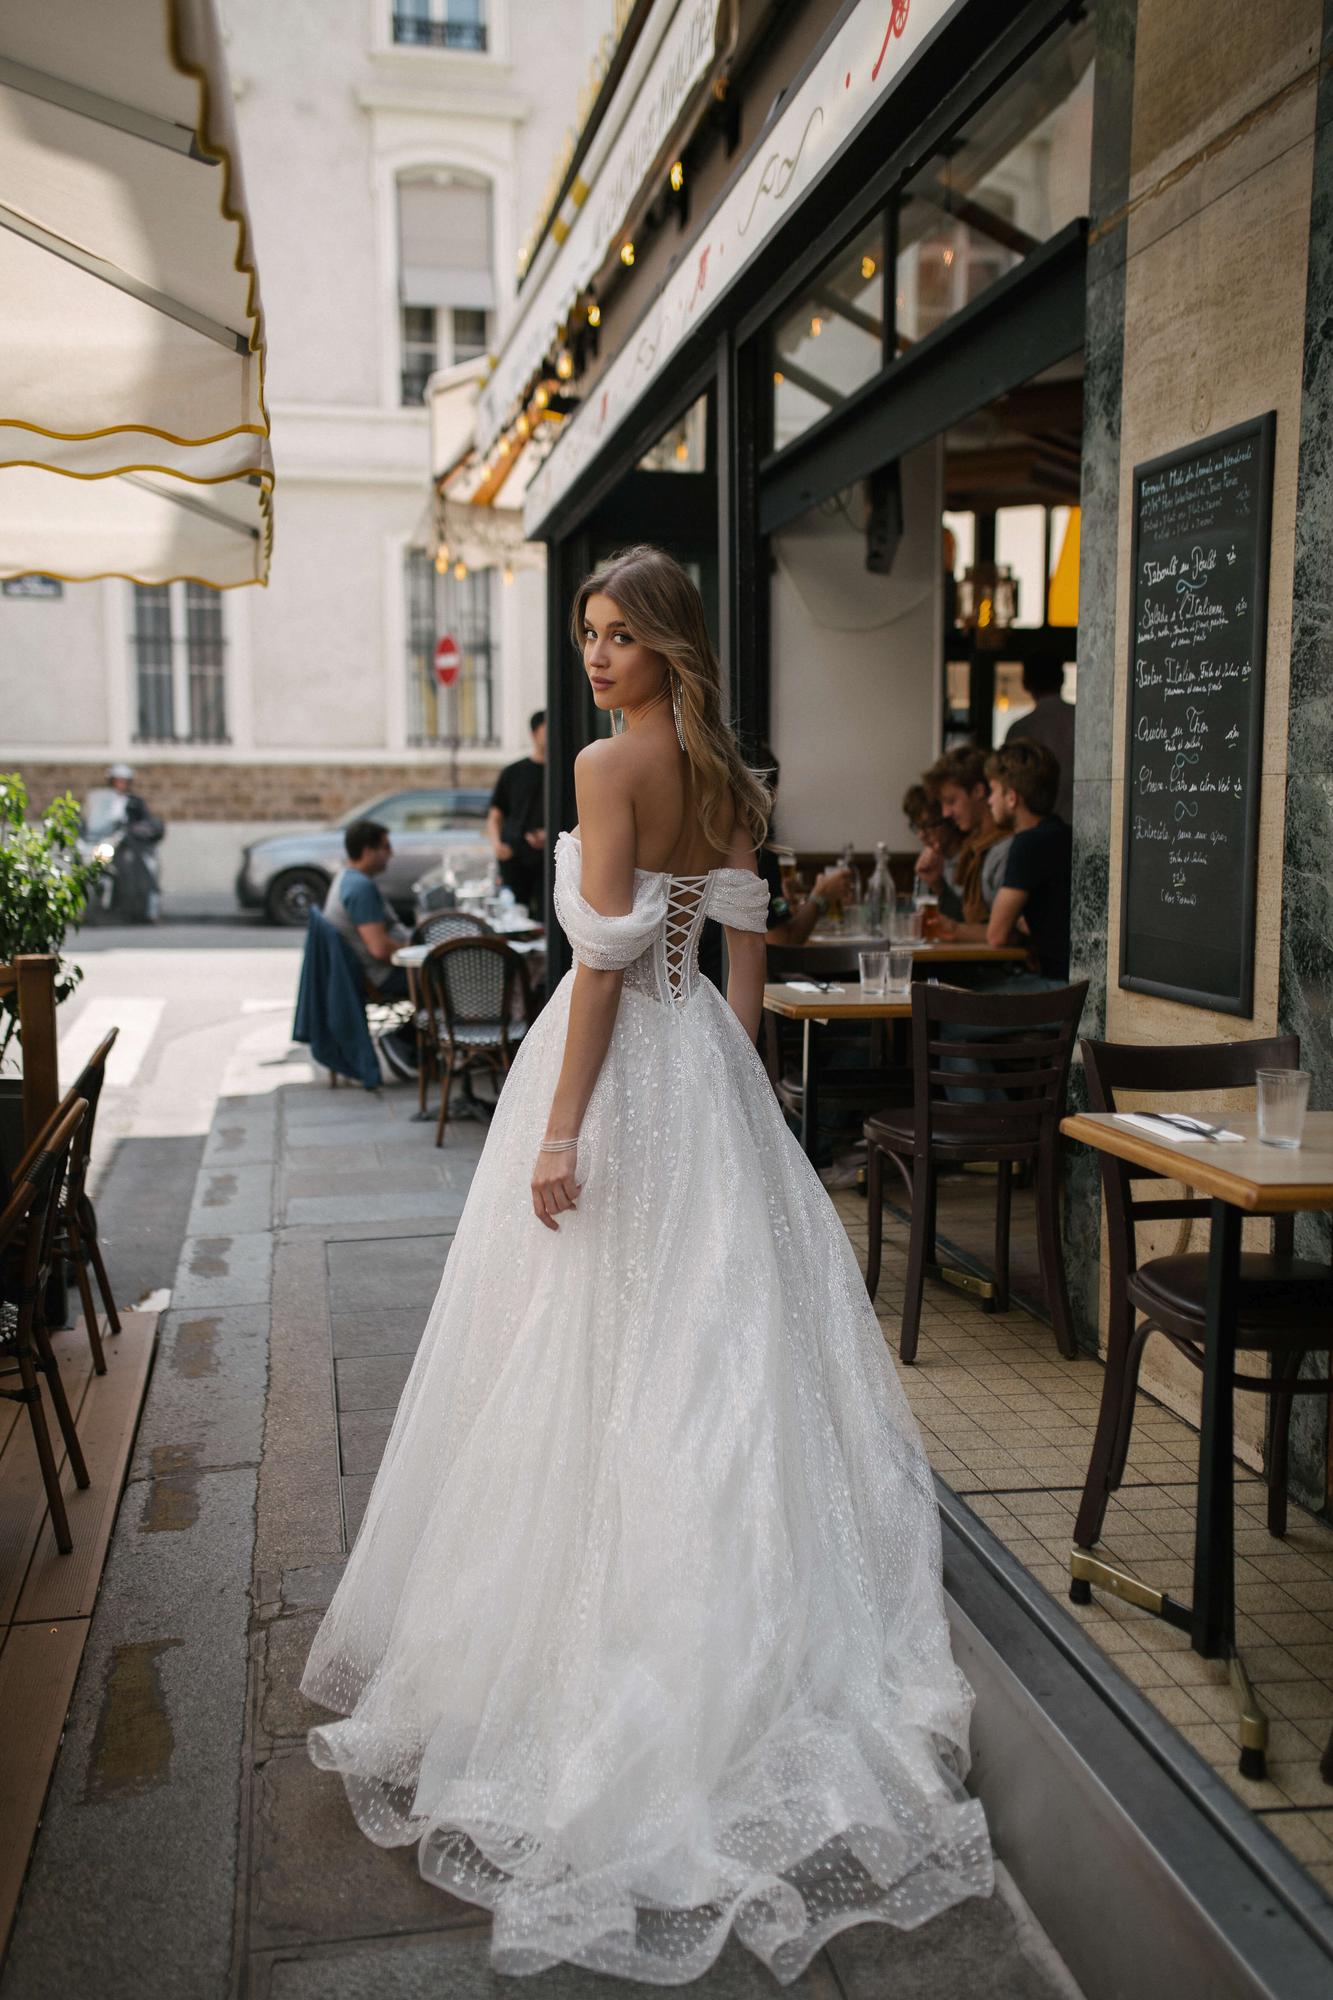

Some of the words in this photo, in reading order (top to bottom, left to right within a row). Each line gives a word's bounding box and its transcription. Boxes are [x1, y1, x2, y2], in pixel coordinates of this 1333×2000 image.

[1179, 562, 1190, 575] au
[1191, 545, 1217, 581] Poulet
[1142, 598, 1169, 630] Salade
[1136, 658, 1163, 689] Tartare
[1170, 725, 1184, 739] au
